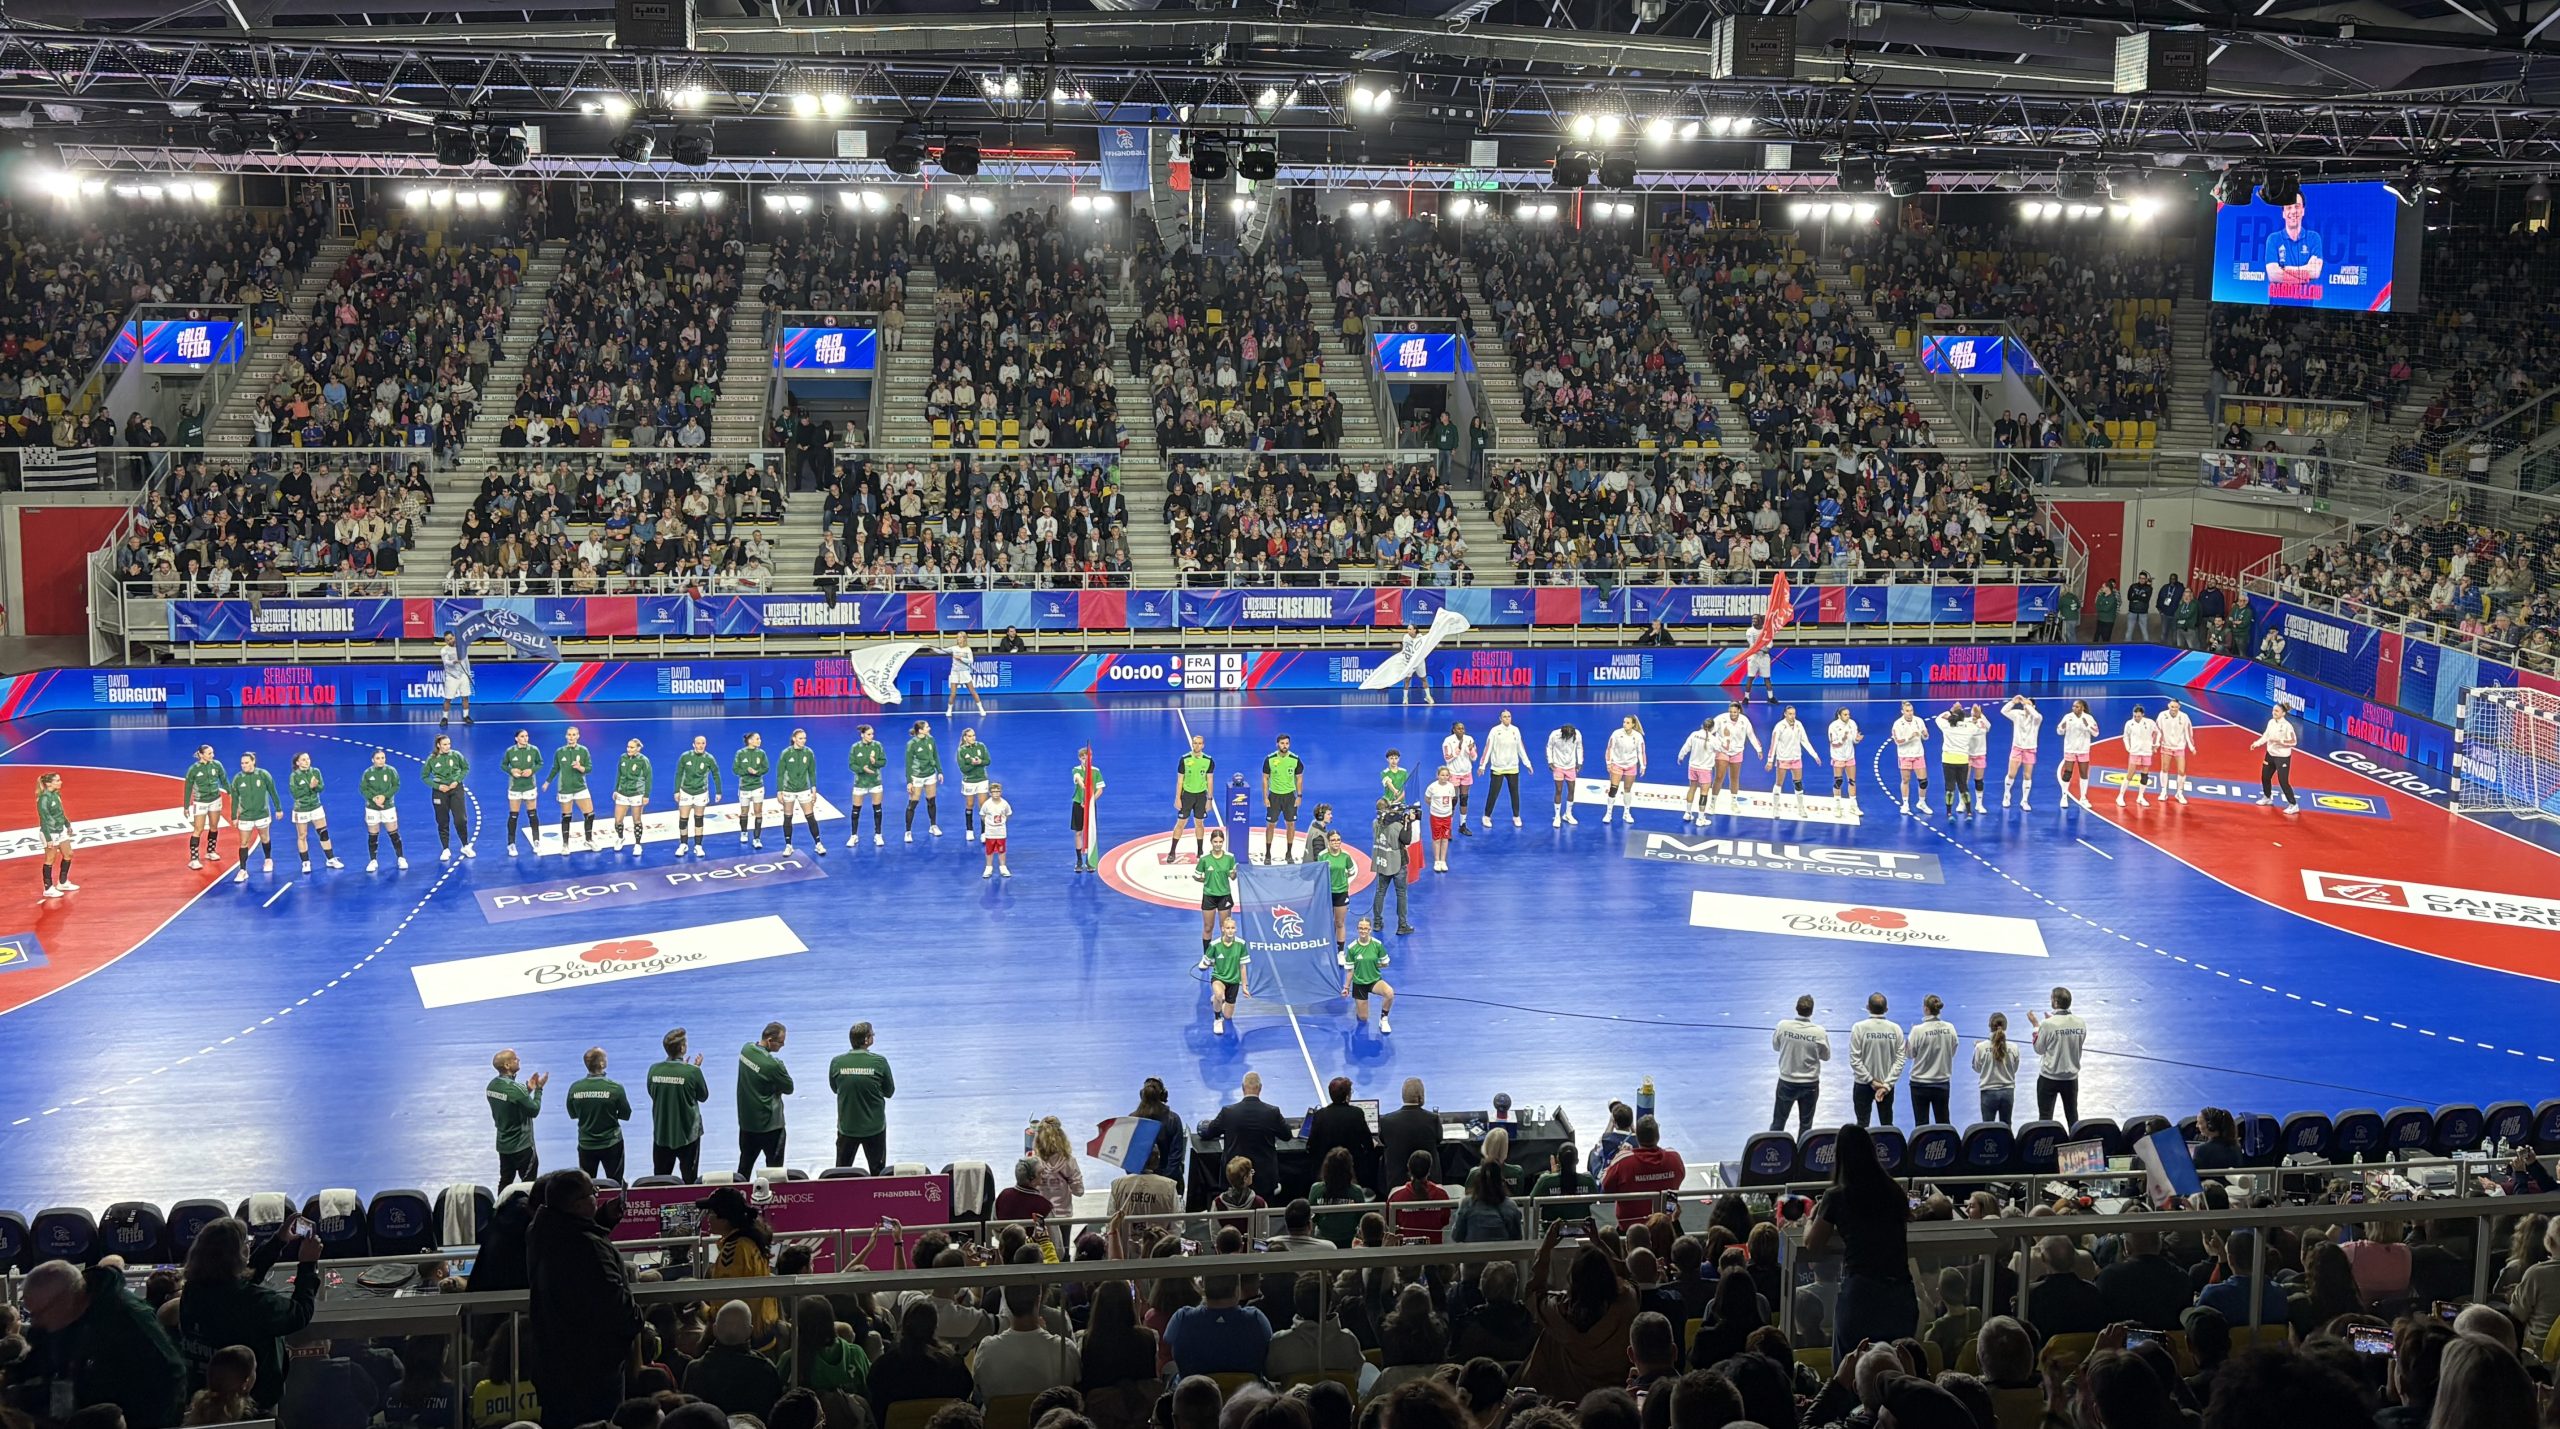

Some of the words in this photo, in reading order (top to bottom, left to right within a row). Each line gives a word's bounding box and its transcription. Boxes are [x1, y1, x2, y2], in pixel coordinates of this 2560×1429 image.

[2329, 274, 2359, 286] LEYNAUD
[177, 326, 207, 343] #BLEU
[814, 333, 843, 350] #BLEU
[1242, 597, 1277, 611] L'HISTOIRE
[1277, 597, 1333, 619] ENSEMBLE
[1691, 595, 1725, 609] L'HISTOIRE
[1725, 595, 1770, 616] ENSEMB
[763, 603, 801, 617] L'HISTOIRE
[800, 602, 861, 625] ENSEMBLE
[290, 607, 355, 633] ENSEMBLE
[2308, 620, 2350, 654] ENSEMBLE
[1187, 657, 1212, 668] FRA
[1227, 657, 1235, 668] 0
[1341, 656, 1360, 669] DAVID
[1611, 654, 1641, 667] AMANDINE
[1823, 652, 1841, 665] DAVID
[2081, 649, 2110, 662] AMANDINE
[671, 666, 690, 679] DAVID
[814, 659, 853, 676] SÉBASTIE
[1109, 665, 1163, 680] 00:00
[1593, 667, 1641, 681] LEYNAUD
[1823, 665, 1870, 679] BURGUIN
[1928, 663, 2006, 682] GARDILLOU
[2064, 661, 2109, 676] LEYNAUD
[108, 674, 129, 687] DAVID
[426, 670, 446, 683] AMAN
[1186, 674, 1212, 685] HON
[1227, 674, 1235, 685] 0
[1341, 668, 1370, 683] BURG
[1452, 668, 1532, 687] GARDILLOU
[408, 683, 447, 698] LEYNA
[671, 679, 725, 694] BURGUIN
[794, 678, 866, 698] GARDILL
[108, 688, 167, 703] BURGUIN
[242, 685, 336, 705] GARDILLOU
[2273, 688, 2306, 712] BURGUIN
[2347, 715, 2408, 756] GARDILLOU
[2328, 750, 2447, 797] Gerflor
[2461, 756, 2497, 783] EYNAUD
[1646, 833, 1921, 870] MILLET
[1644, 848, 1759, 868] Fenêtres
[1765, 859, 1793, 870] et
[1802, 861, 1926, 881] Façades
[493, 879, 638, 909] Prefon
[666, 858, 802, 886] Prefon
[1819, 914, 1839, 926] la
[1782, 913, 1950, 943] Boulangère
[524, 951, 707, 985] Boulangère
[566, 958, 588, 971] la
